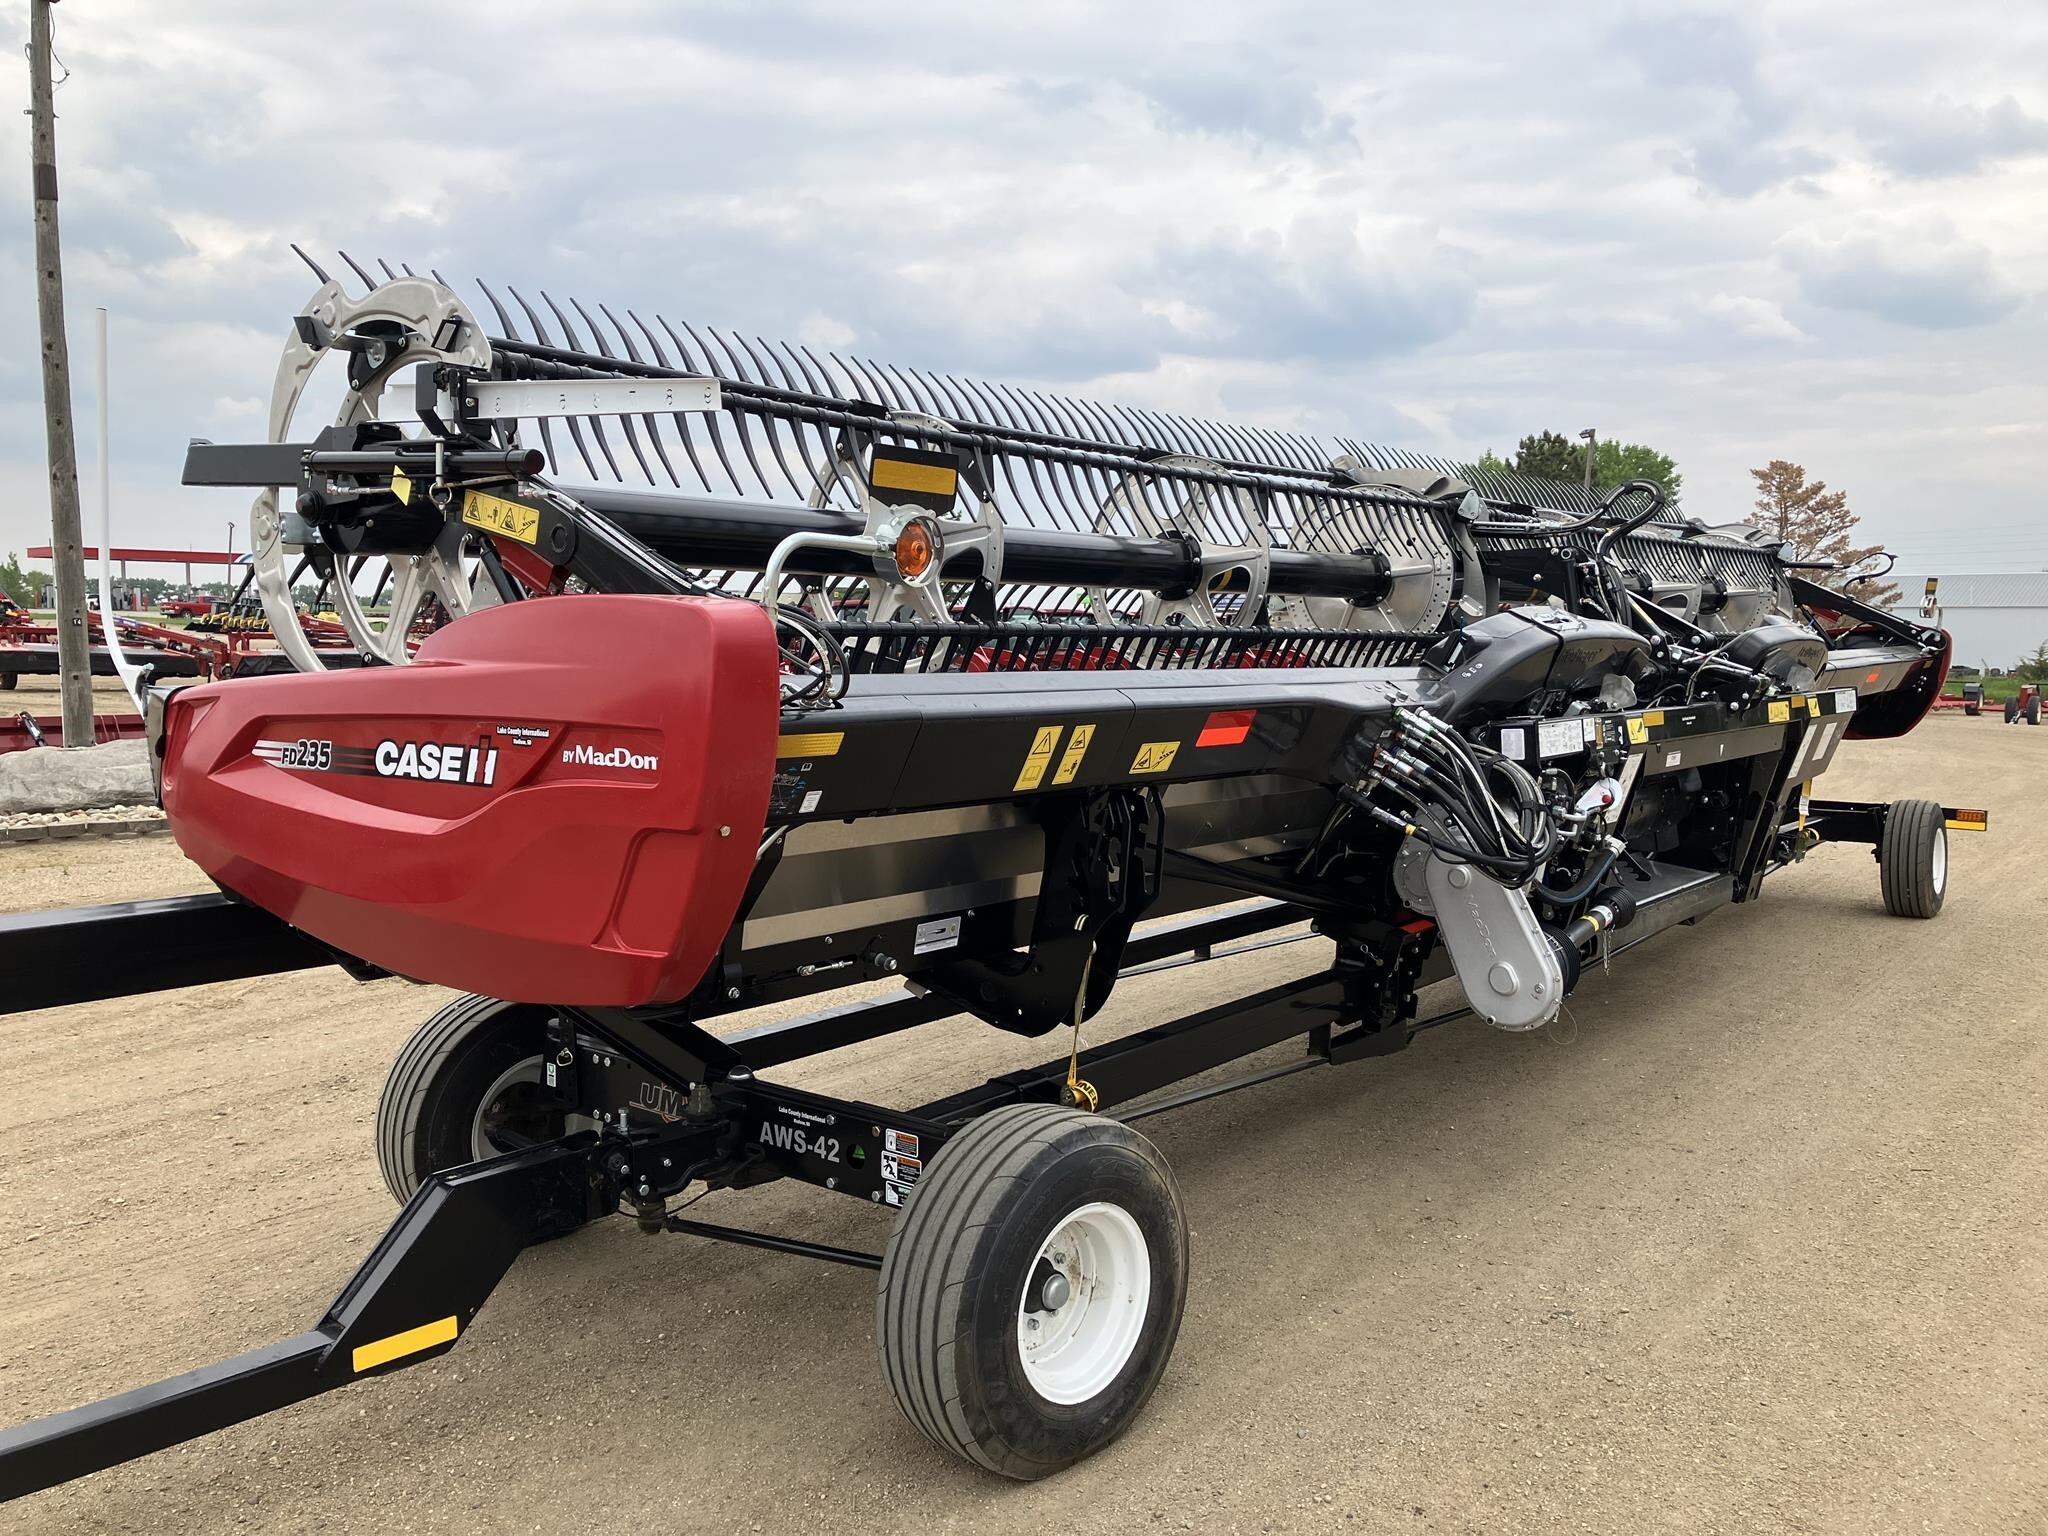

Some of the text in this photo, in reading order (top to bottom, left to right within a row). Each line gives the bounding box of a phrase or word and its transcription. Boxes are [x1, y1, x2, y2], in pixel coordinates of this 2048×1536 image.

[281, 739, 333, 771] FD235
[374, 740, 464, 781] CASE
[562, 744, 659, 771] BY MacDon
[759, 1121, 841, 1164] AWS-42
